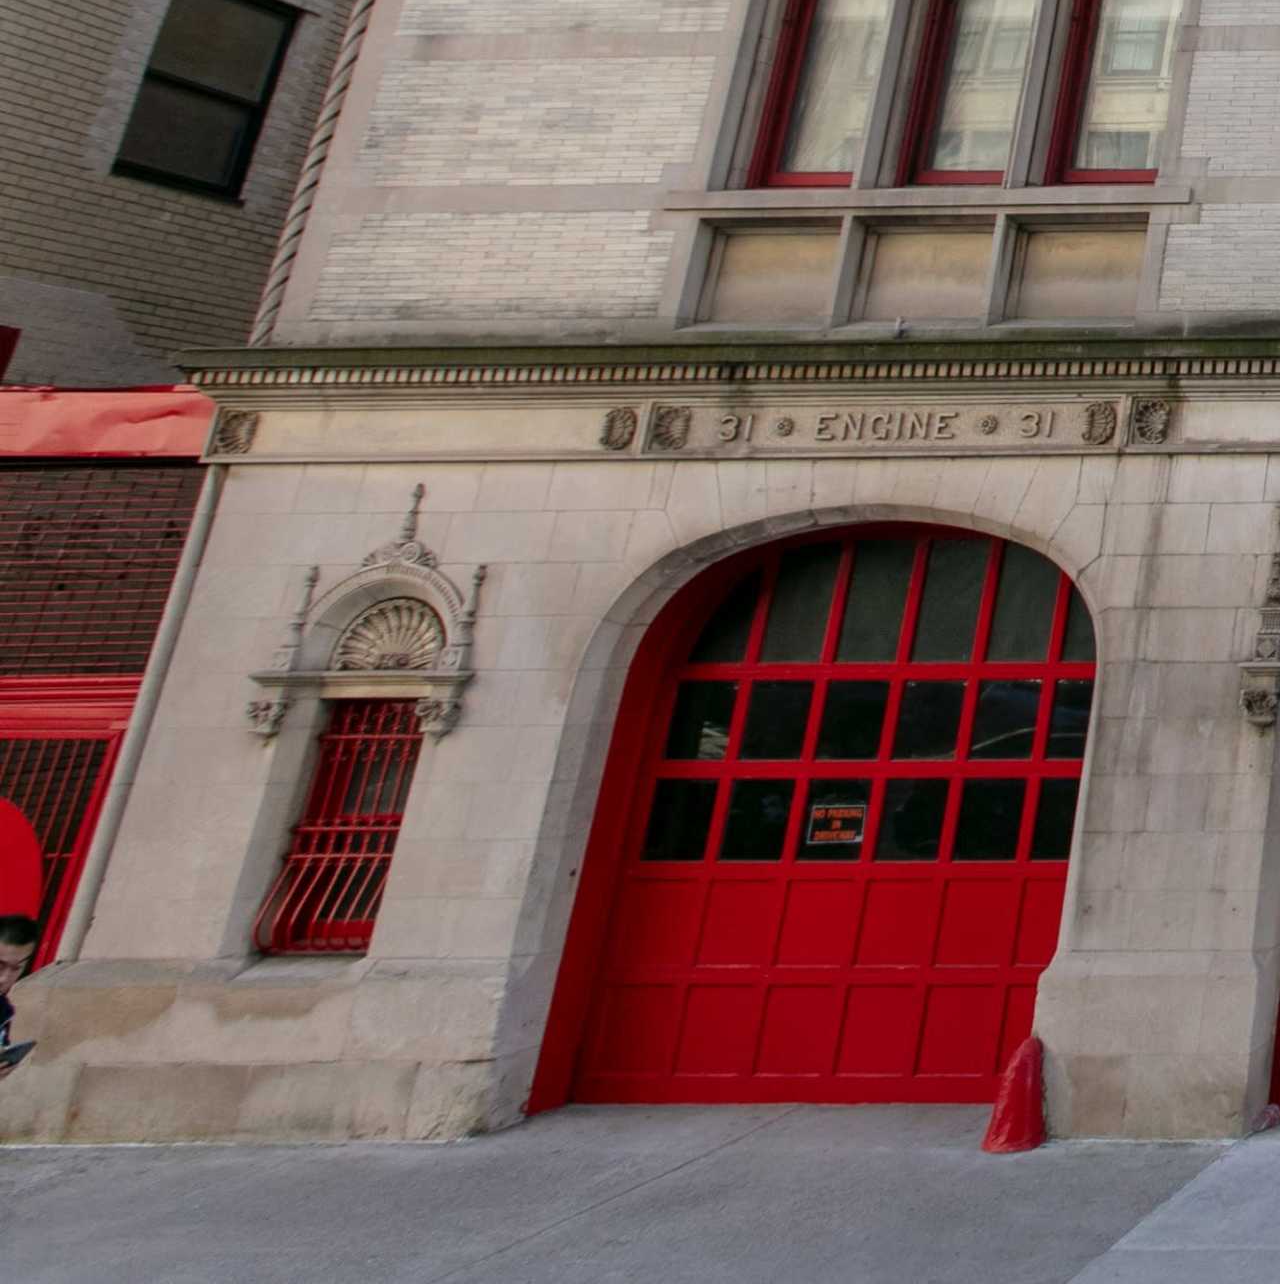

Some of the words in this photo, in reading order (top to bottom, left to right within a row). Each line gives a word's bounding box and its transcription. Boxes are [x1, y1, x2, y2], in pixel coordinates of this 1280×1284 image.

[719, 414, 754, 443] 31
[813, 412, 959, 442] ENGINE
[1021, 411, 1056, 439] 31
